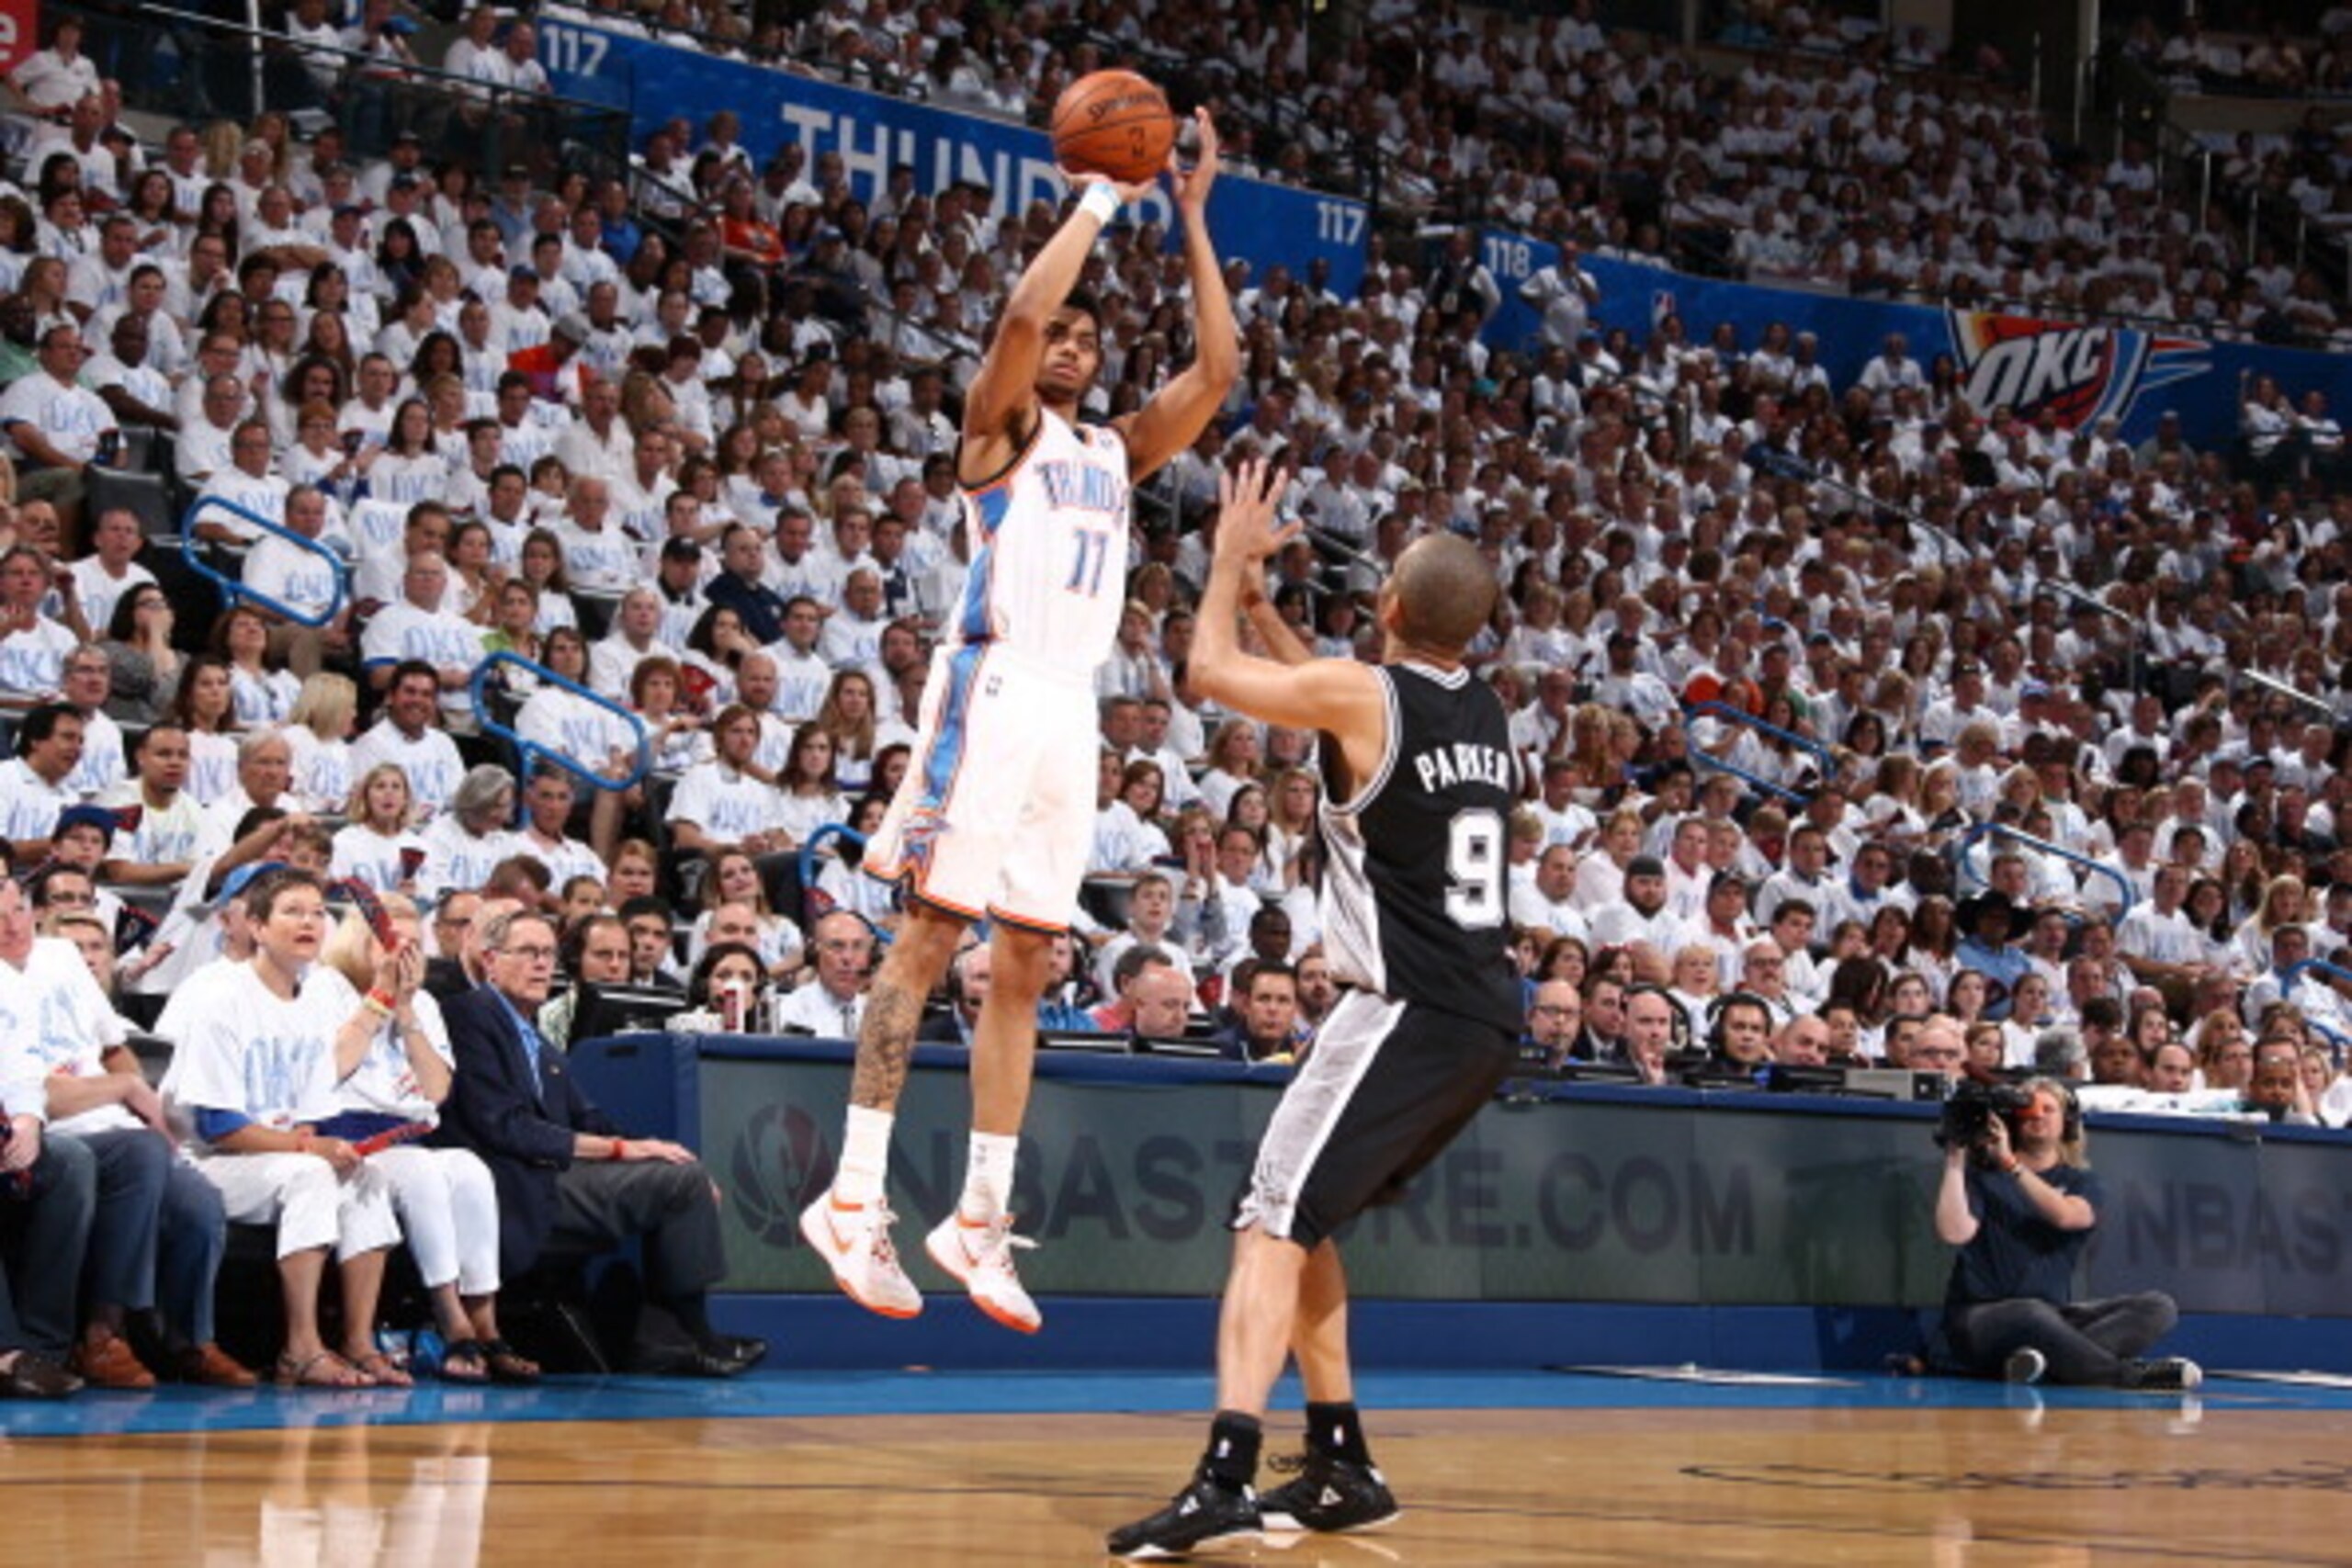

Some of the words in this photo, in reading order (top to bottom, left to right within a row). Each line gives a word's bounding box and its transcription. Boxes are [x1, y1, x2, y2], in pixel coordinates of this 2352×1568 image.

[542, 25, 609, 76] 117
[1317, 201, 1365, 246] 117
[1485, 237, 1530, 277] 118
[1965, 328, 2108, 419] OKC
[1065, 527, 1107, 597] 11
[1445, 808, 1505, 931] 9
[2124, 1179, 2352, 1276] NBAS
